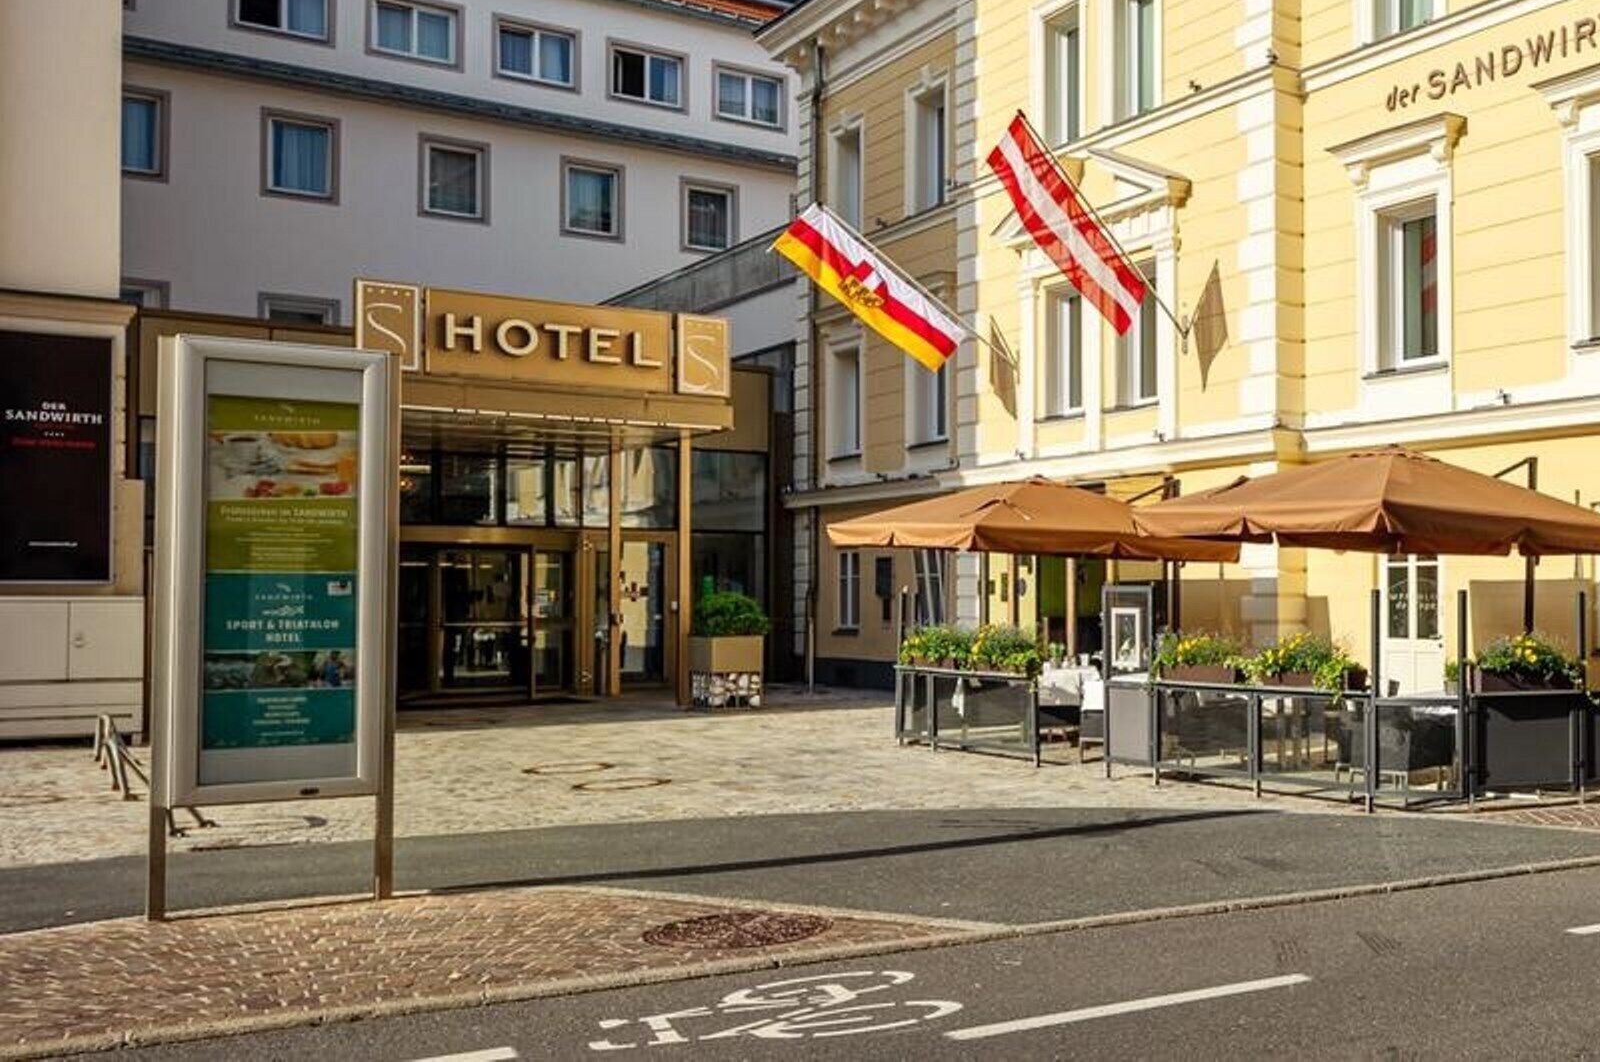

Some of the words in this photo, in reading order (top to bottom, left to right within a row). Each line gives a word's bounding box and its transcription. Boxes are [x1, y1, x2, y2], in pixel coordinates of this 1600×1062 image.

[1386, 84, 1420, 112] der
[443, 313, 663, 367] HOTEL
[5, 409, 103, 424] SANDWIRTH
[226, 619, 263, 631] SPORT
